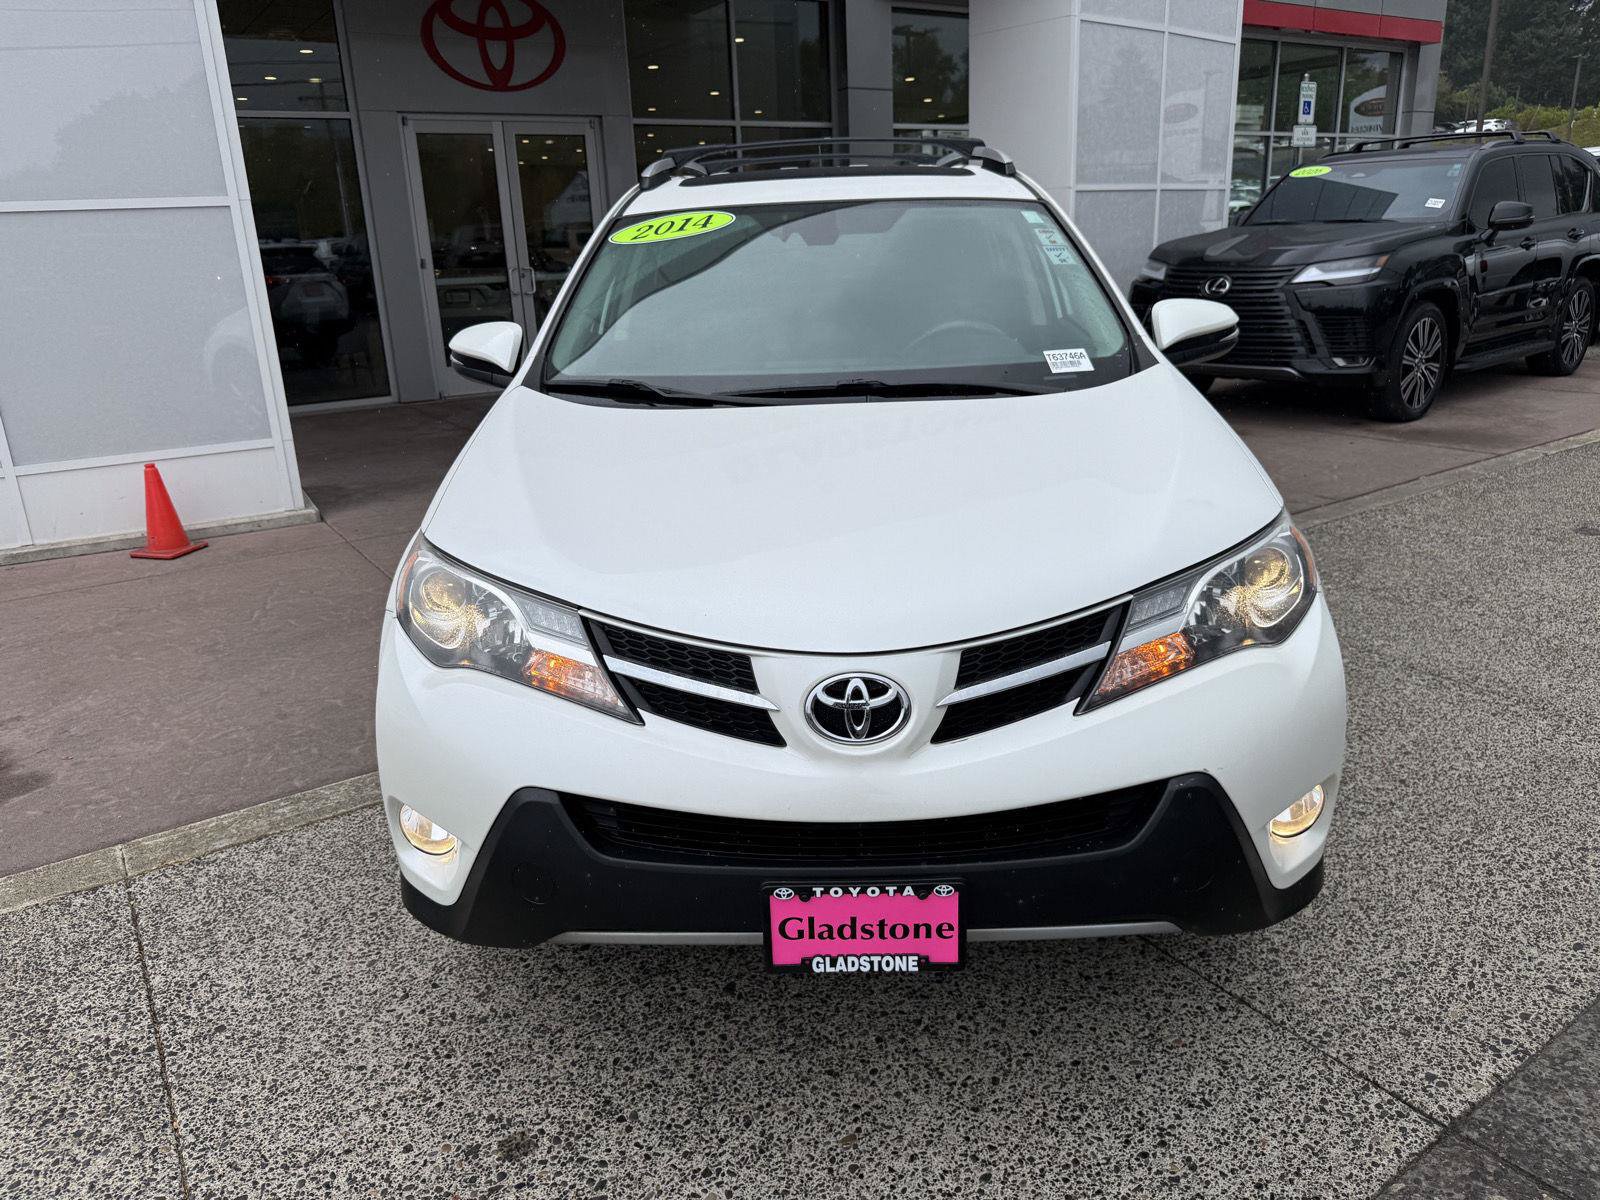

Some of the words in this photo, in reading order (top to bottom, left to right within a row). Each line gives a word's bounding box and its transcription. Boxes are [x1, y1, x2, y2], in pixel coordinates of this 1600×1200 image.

[630, 214, 715, 241] 2014
[1046, 352, 1087, 361] T63746A
[812, 886, 915, 898] TOYOTA
[778, 916, 955, 941] Gladstone
[812, 955, 919, 973] GLADSTONE
